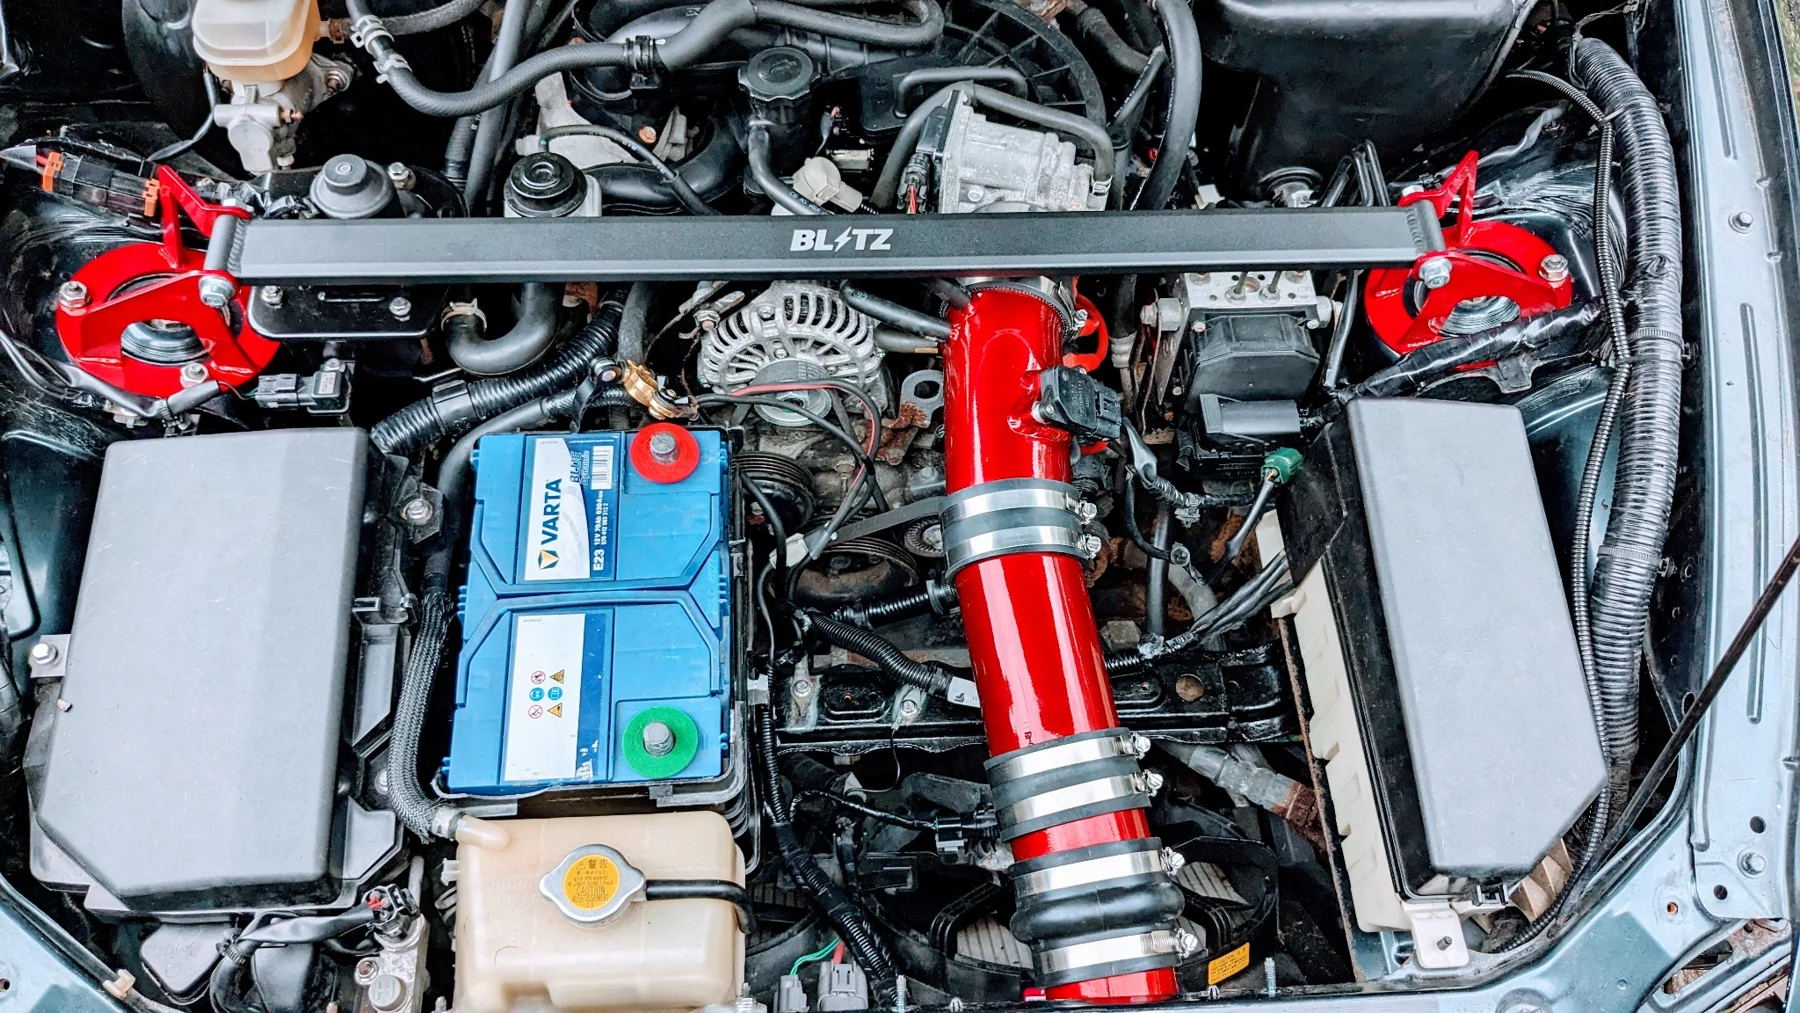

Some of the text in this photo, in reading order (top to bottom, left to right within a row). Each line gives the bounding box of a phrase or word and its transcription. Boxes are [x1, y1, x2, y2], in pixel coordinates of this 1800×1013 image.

[790, 226, 893, 252] BLITZ
[570, 451, 582, 483] BLUE
[540, 479, 562, 545] VARTA
[592, 549, 605, 571] E23
[588, 859, 608, 869] 警告
[576, 885, 606, 894] CAUTION
